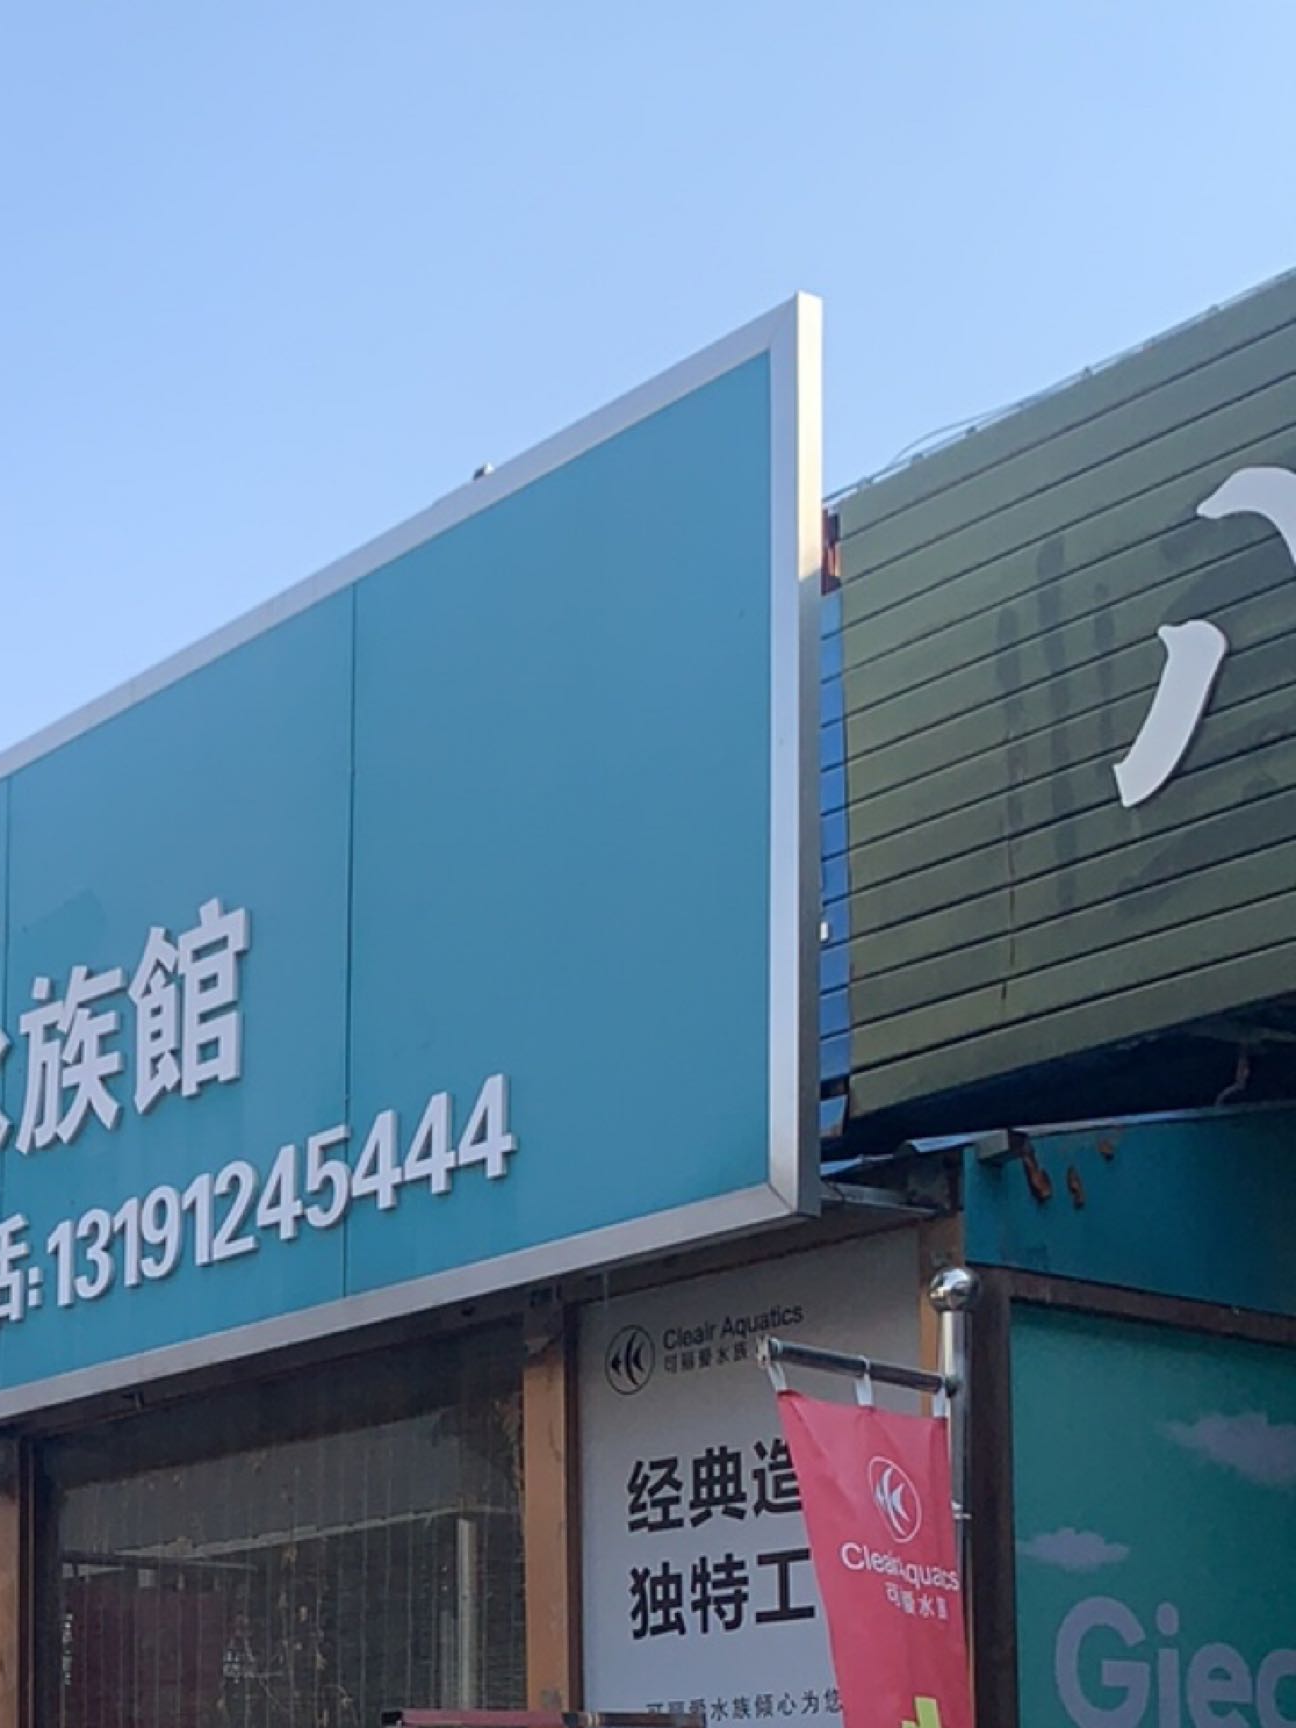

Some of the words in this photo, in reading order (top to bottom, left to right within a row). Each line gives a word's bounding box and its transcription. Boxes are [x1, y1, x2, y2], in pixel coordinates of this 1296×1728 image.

[719, 1304, 804, 1339] Aquatics
[628, 1437, 802, 1532] 经典造
[629, 1547, 816, 1640] 独特工
